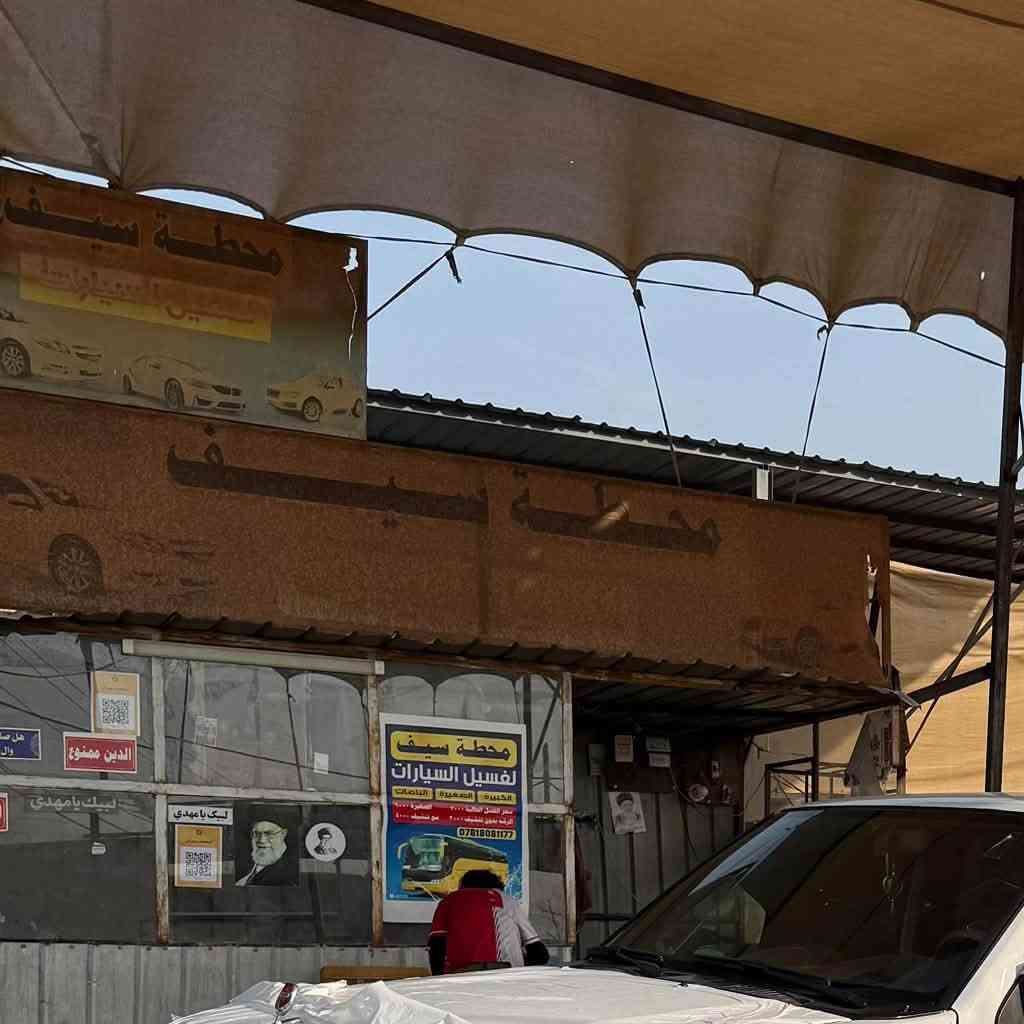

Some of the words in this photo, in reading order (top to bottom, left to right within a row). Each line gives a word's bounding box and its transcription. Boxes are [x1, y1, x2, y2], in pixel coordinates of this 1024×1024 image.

[396, 734, 449, 760] سيف
[456, 736, 511, 761] محطة
[391, 762, 460, 784] السيارات
[463, 768, 517, 787] لغسيل
